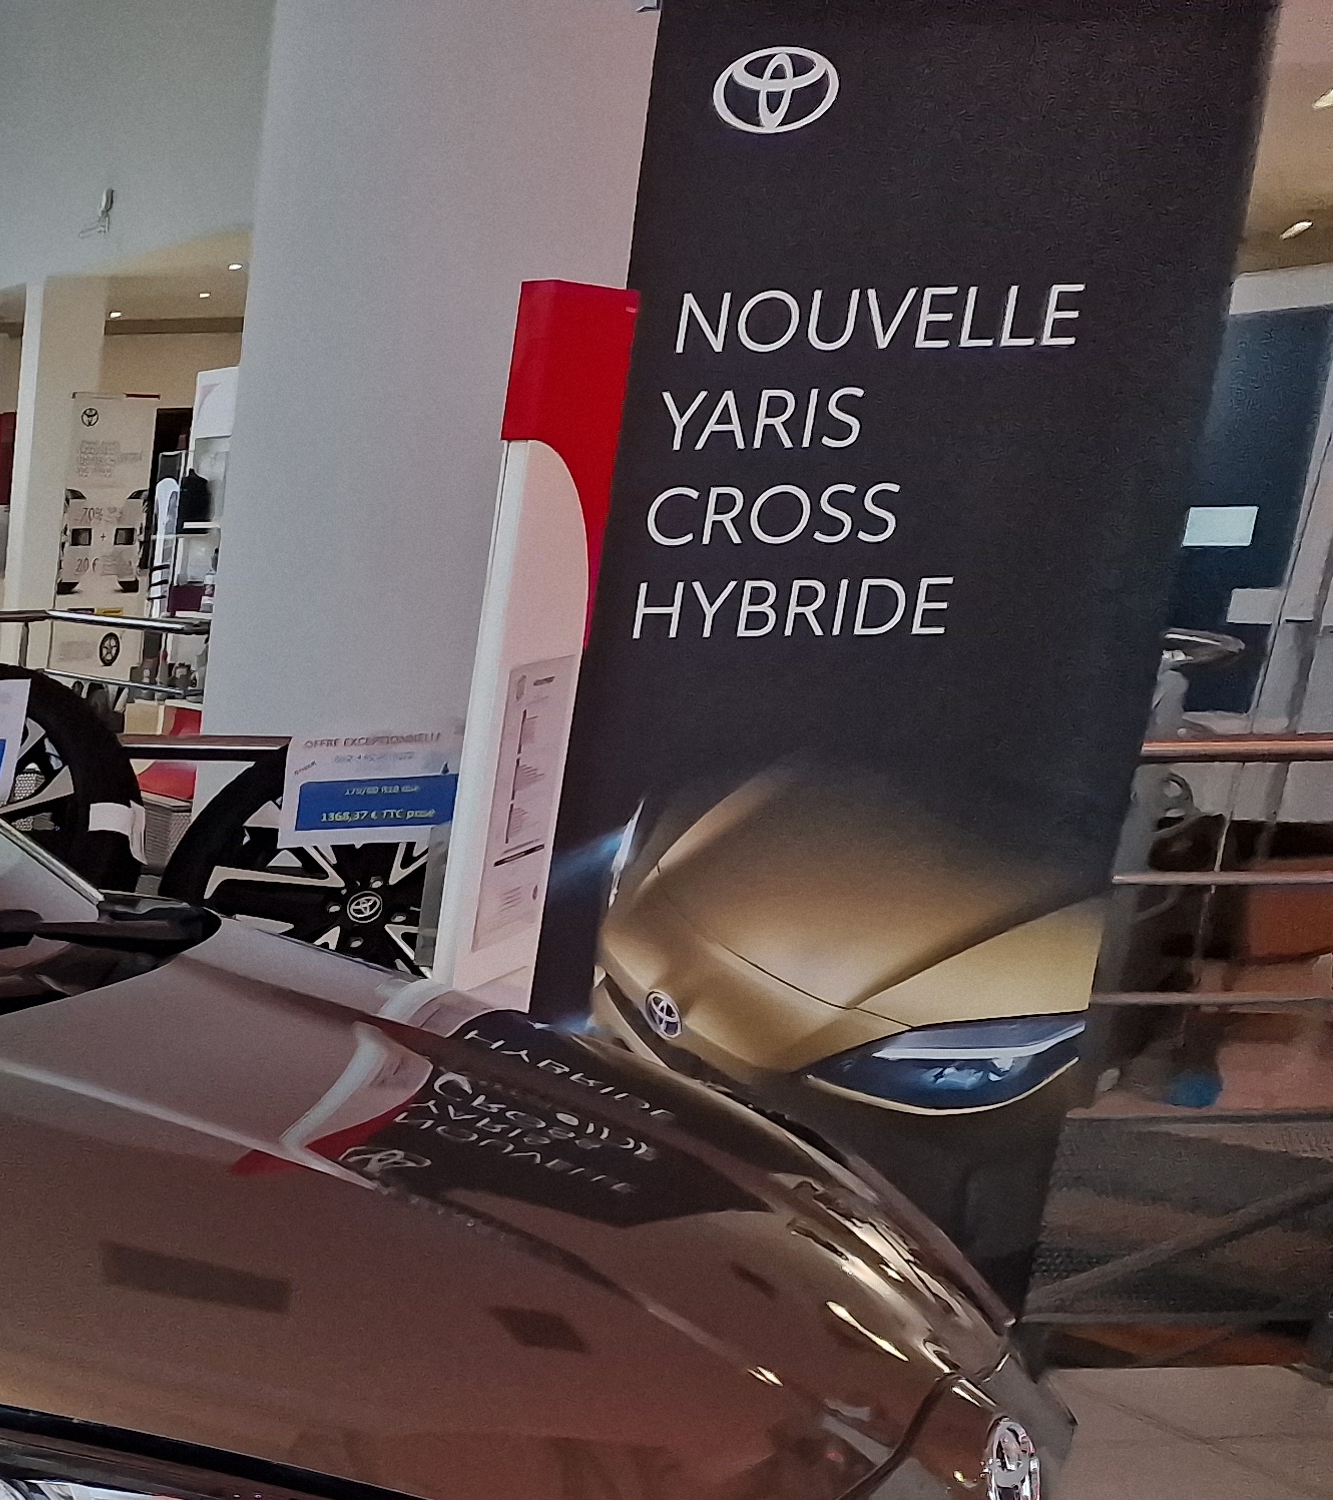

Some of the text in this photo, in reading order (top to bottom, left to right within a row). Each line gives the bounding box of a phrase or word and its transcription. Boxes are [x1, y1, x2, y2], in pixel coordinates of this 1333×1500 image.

[674, 283, 1086, 354] NOUVELLE
[661, 386, 866, 451] YARIS
[645, 482, 901, 546] CROSS
[632, 576, 955, 640] HYBRIDE
[382, 810, 404, 819] TTC
